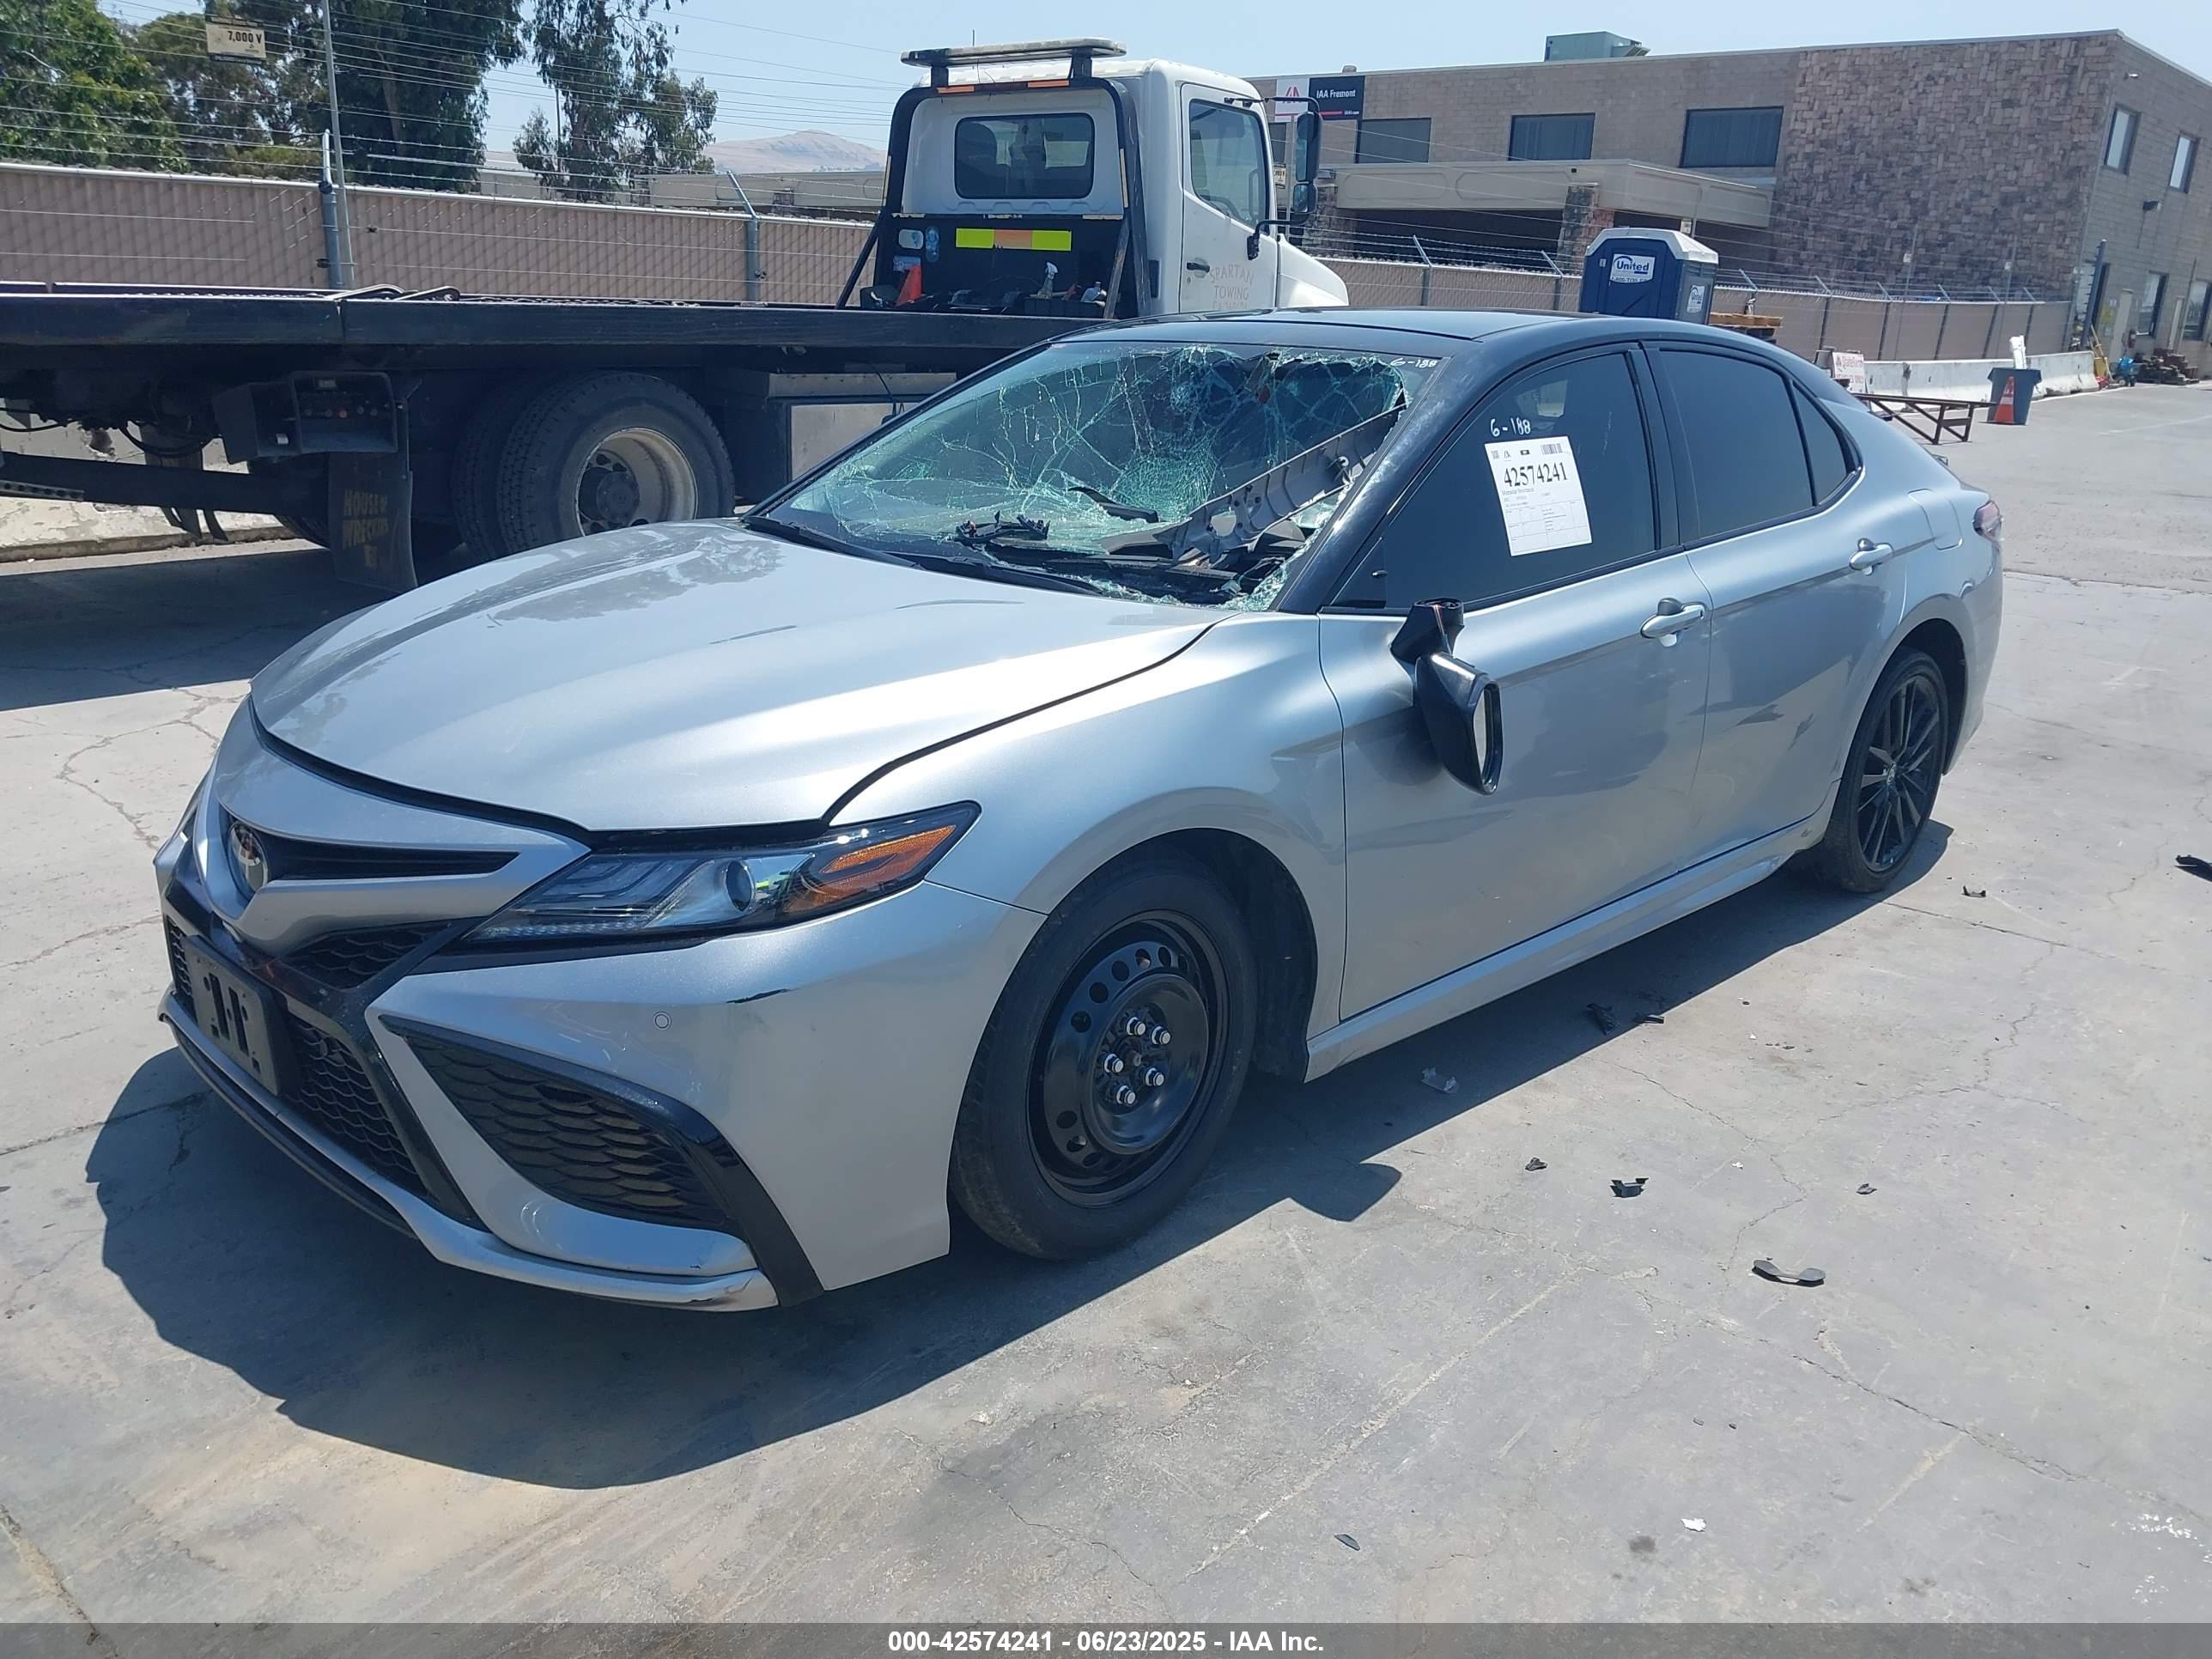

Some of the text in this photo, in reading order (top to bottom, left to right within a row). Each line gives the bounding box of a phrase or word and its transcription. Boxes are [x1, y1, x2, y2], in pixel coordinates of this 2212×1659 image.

[228, 30, 262, 44] 7,000 V
[1316, 89, 1356, 99] IAA Fremont
[1616, 260, 1650, 272] United
[1209, 263, 1255, 287] SPARTAN
[1214, 285, 1249, 301] TOWING
[1389, 357, 1437, 368] 6-188
[1490, 416, 1531, 437] 6-188
[1504, 461, 1569, 488] 42574241
